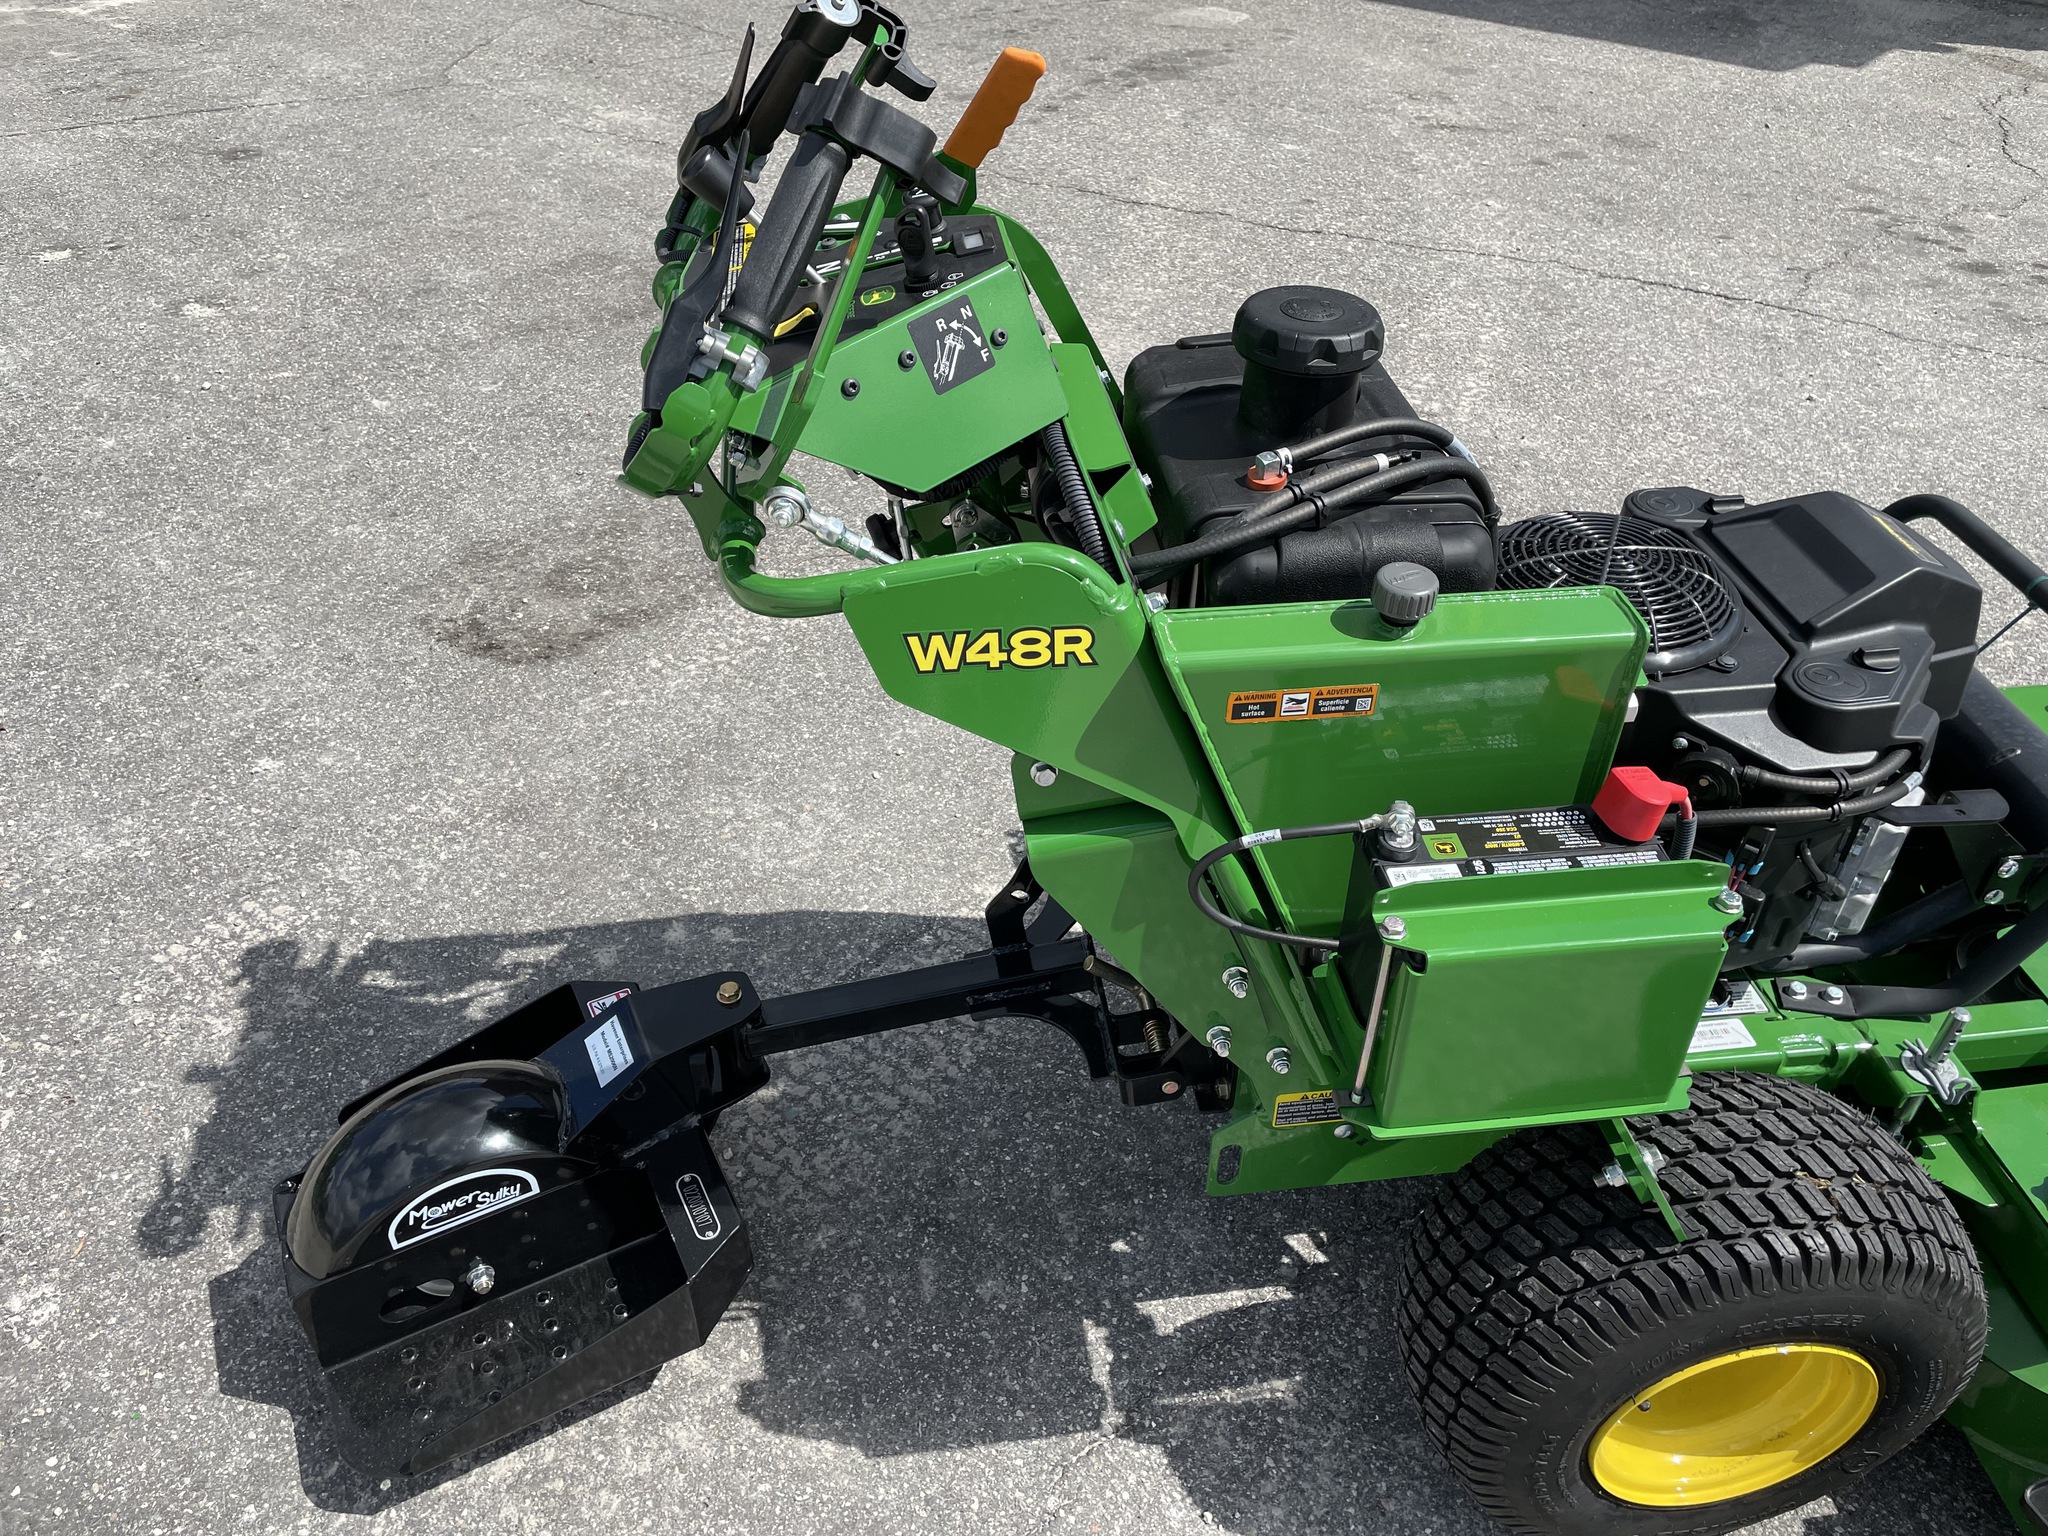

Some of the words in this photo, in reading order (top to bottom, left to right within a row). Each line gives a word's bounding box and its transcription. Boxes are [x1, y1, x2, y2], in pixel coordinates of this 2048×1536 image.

[960, 305, 973, 320] N
[935, 318, 947, 332] R
[980, 348, 990, 362] F
[903, 626, 1099, 674] W48R
[1243, 693, 1277, 701] WARNING
[1326, 687, 1373, 695] ADVERTENCIA
